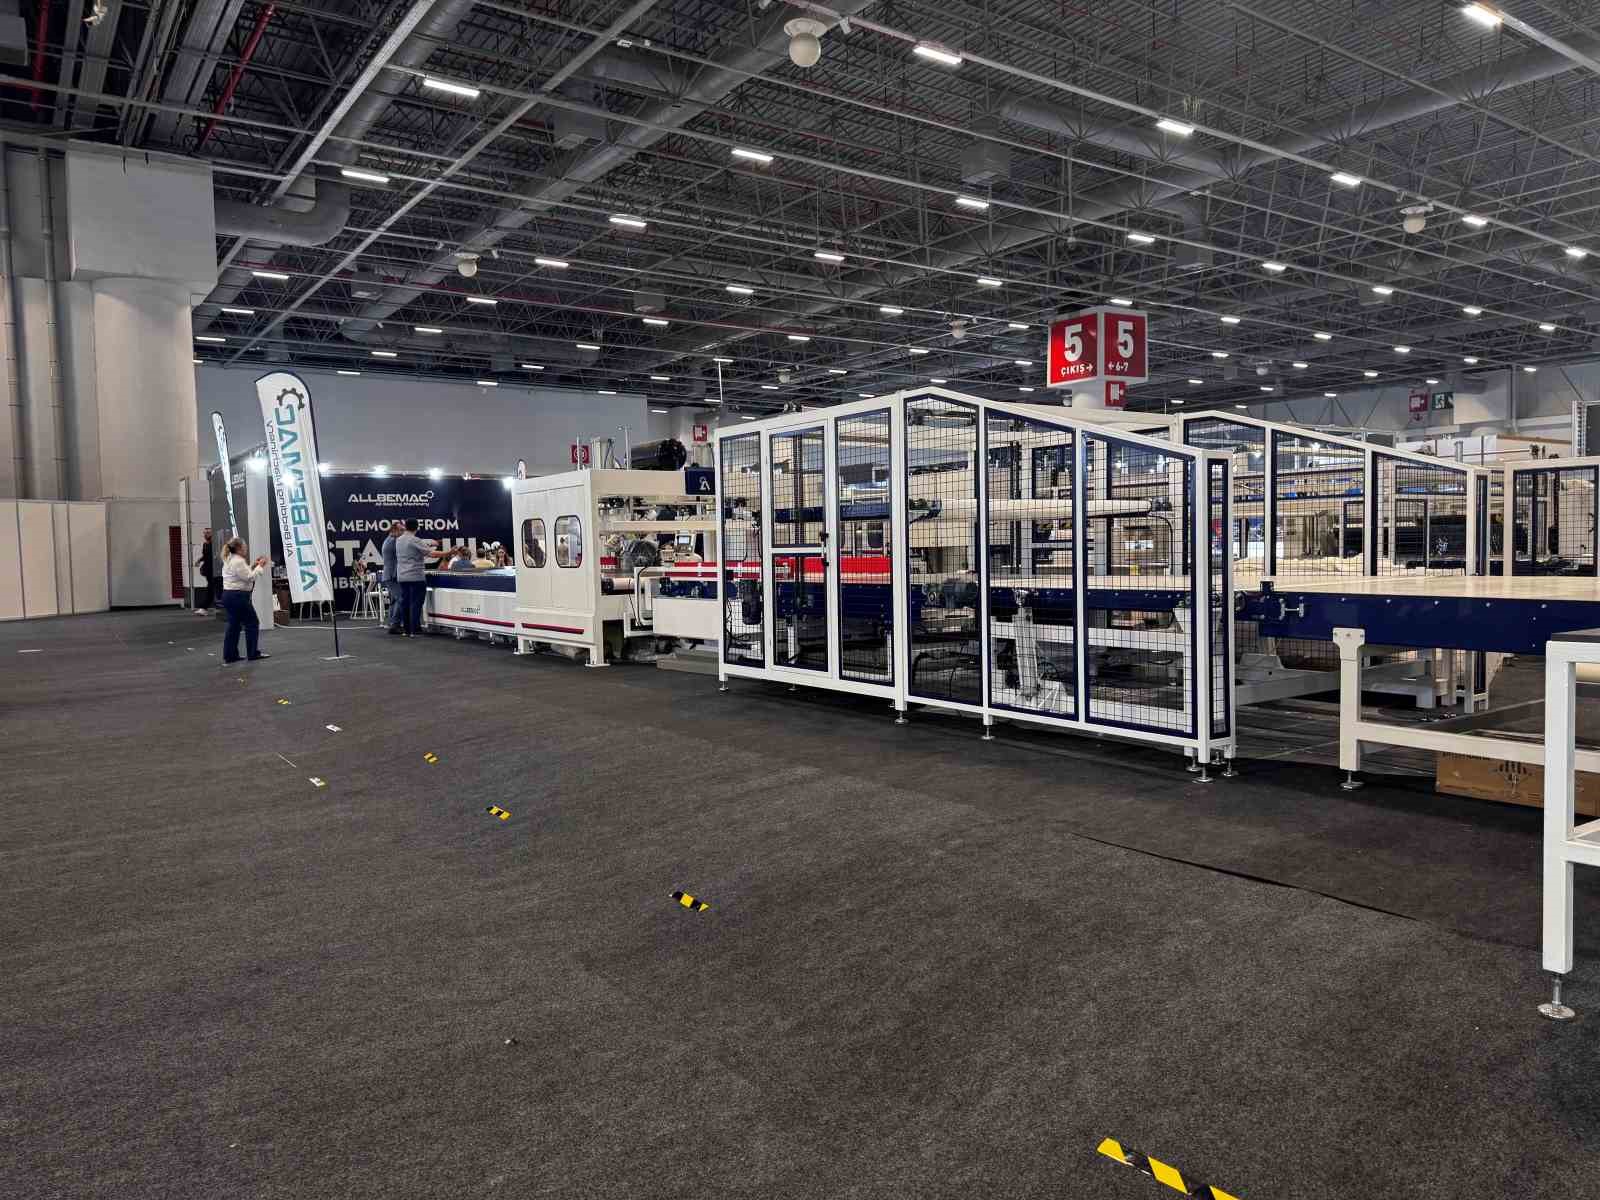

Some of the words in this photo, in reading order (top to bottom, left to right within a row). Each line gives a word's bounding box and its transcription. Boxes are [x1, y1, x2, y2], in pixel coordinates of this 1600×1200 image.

[1064, 323, 1083, 362] 5
[1117, 320, 1134, 359] 5
[1061, 363, 1086, 377] ÇIKIŞ
[348, 494, 429, 503] ALLBEMAC
[327, 522, 336, 532] A
[341, 519, 406, 532] MEMO
[416, 518, 459, 530] FROM
